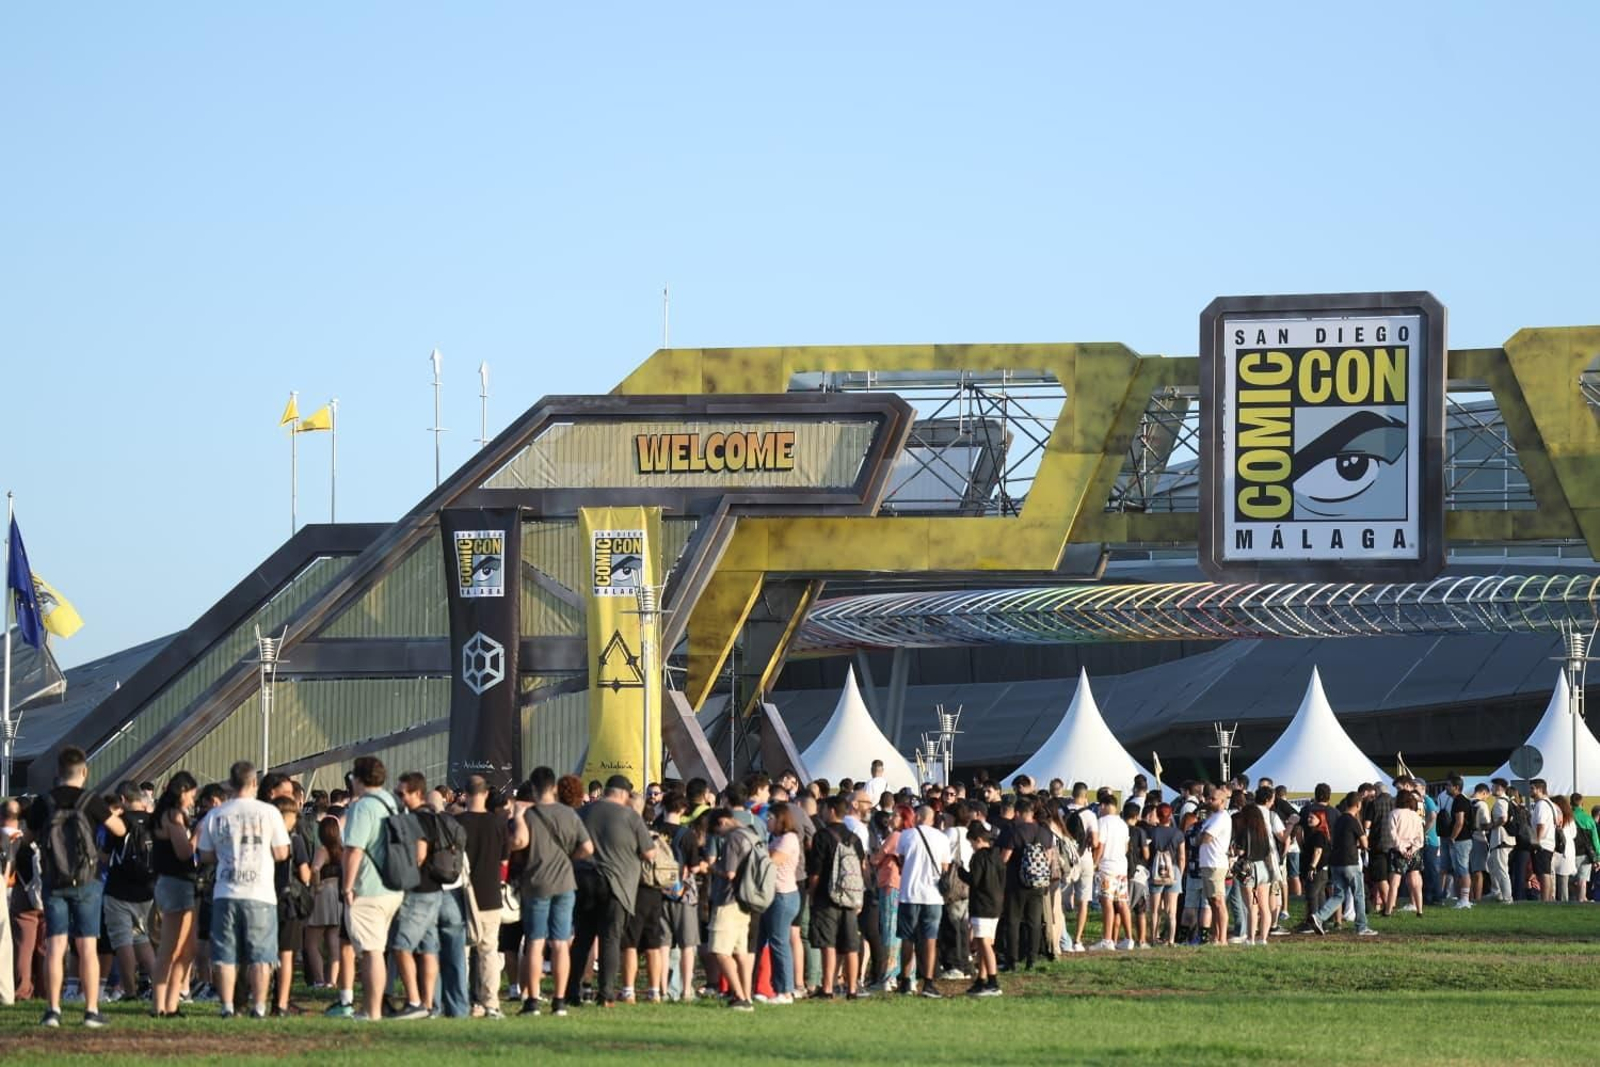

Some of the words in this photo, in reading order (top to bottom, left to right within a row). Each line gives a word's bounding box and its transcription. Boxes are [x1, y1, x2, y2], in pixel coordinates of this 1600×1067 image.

[1234, 328, 1289, 345] SAN
[1315, 326, 1409, 344] DIEGO
[1298, 348, 1406, 404] CON
[635, 431, 796, 474] WELCOME
[1237, 351, 1293, 519] COMIC
[473, 539, 501, 555] CON
[612, 538, 642, 554] CON
[1235, 524, 1407, 550] MÁLAGA
[458, 539, 473, 587] COMIC
[595, 539, 612, 586] COMIC
